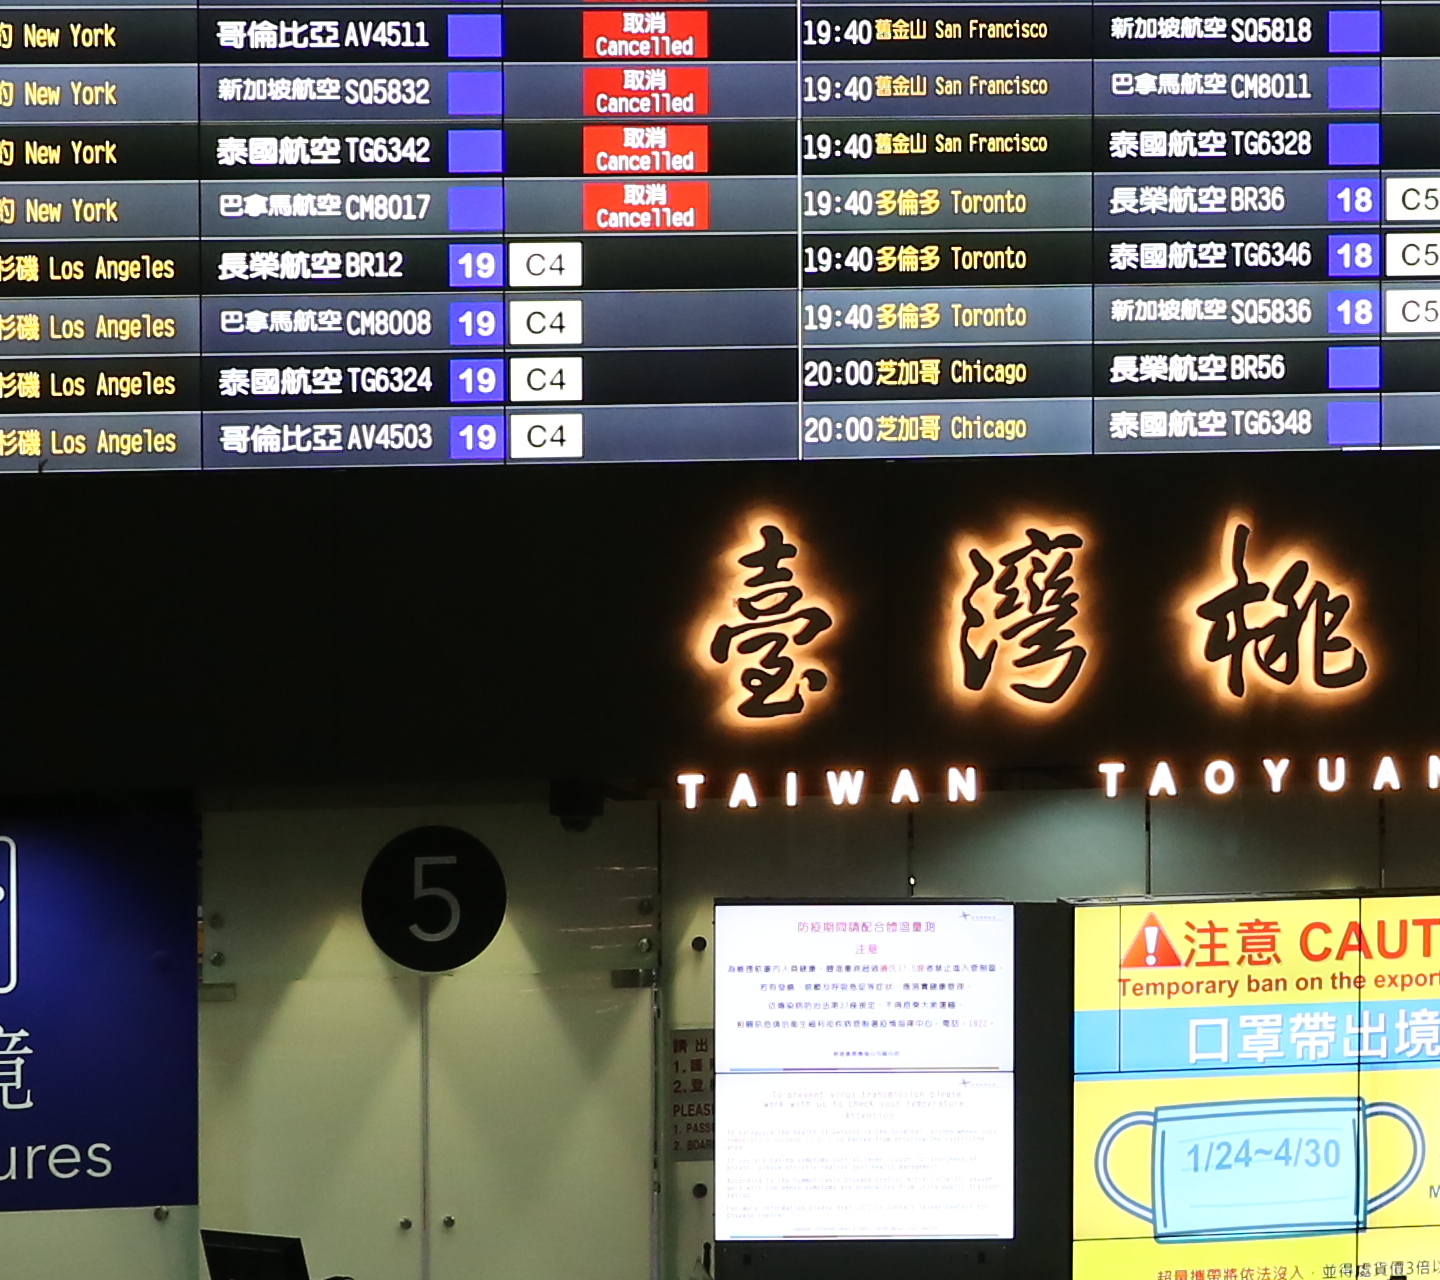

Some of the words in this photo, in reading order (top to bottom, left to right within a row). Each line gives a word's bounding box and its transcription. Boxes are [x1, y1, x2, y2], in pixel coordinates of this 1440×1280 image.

[804, 190, 872, 216] 19:40
[875, 189, 940, 215] 多倫多
[951, 190, 1026, 213] Toronto
[1110, 186, 1226, 214] 長榮航空
[1231, 187, 1284, 211] BR36
[1337, 187, 1372, 212] 18
[1402, 188, 1439, 210] C5
[50, 257, 84, 280] Los
[96, 255, 174, 281] Angeles
[218, 251, 342, 280] 長榮航空
[346, 252, 402, 277] BR12
[459, 253, 495, 278] 19
[526, 254, 565, 276] C4
[678, 767, 976, 808] TAIWAN
[409, 856, 460, 942] 5
[1180, 919, 1281, 967] 注意
[1117, 978, 1239, 999] Temporary
[1247, 976, 1287, 992] ban
[1296, 976, 1322, 991] on
[1331, 973, 1366, 989] the
[673, 1104, 714, 1116] PLEAS
[1186, 1137, 1341, 1175] 1/24~4/30
